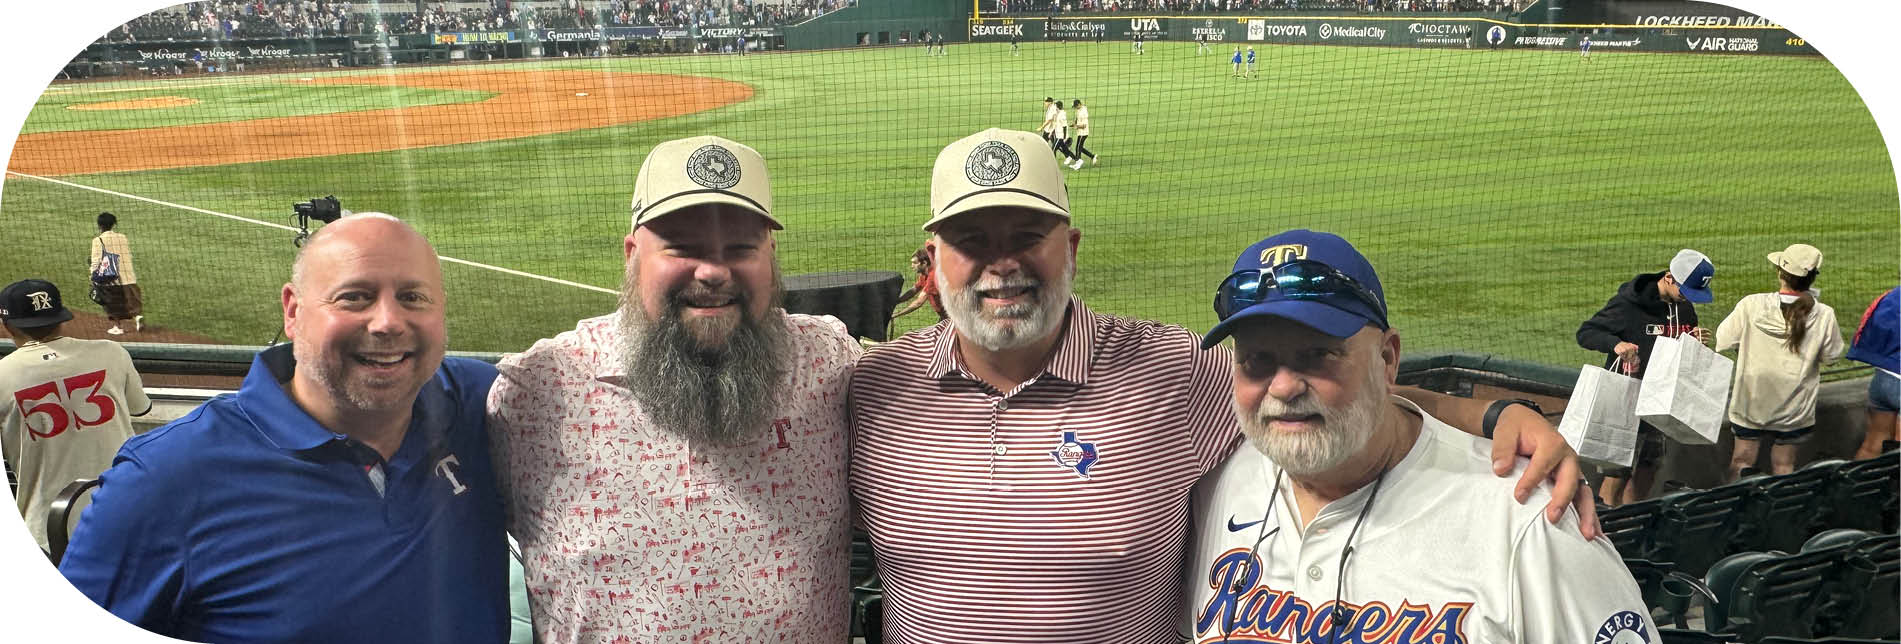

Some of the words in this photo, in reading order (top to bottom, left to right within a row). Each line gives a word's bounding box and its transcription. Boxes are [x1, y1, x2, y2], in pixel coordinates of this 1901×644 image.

[1131, 18, 1160, 31] UTA
[1635, 15, 1731, 28] LOCKHEED
[547, 29, 600, 42] Germania
[972, 24, 1023, 36] SEATGEEK
[1266, 25, 1307, 36] TOYOTA
[1333, 27, 1366, 37] Medical
[1367, 27, 1386, 39] City
[1515, 36, 1567, 46] PROGRESSIVE
[1701, 37, 1726, 51] AIR
[1728, 43, 1758, 51] GUARD
[1786, 38, 1805, 46] 410
[14, 369, 116, 441] 53
[768, 418, 792, 448] T
[435, 454, 467, 495] T
[1197, 547, 1475, 644] Rangers
